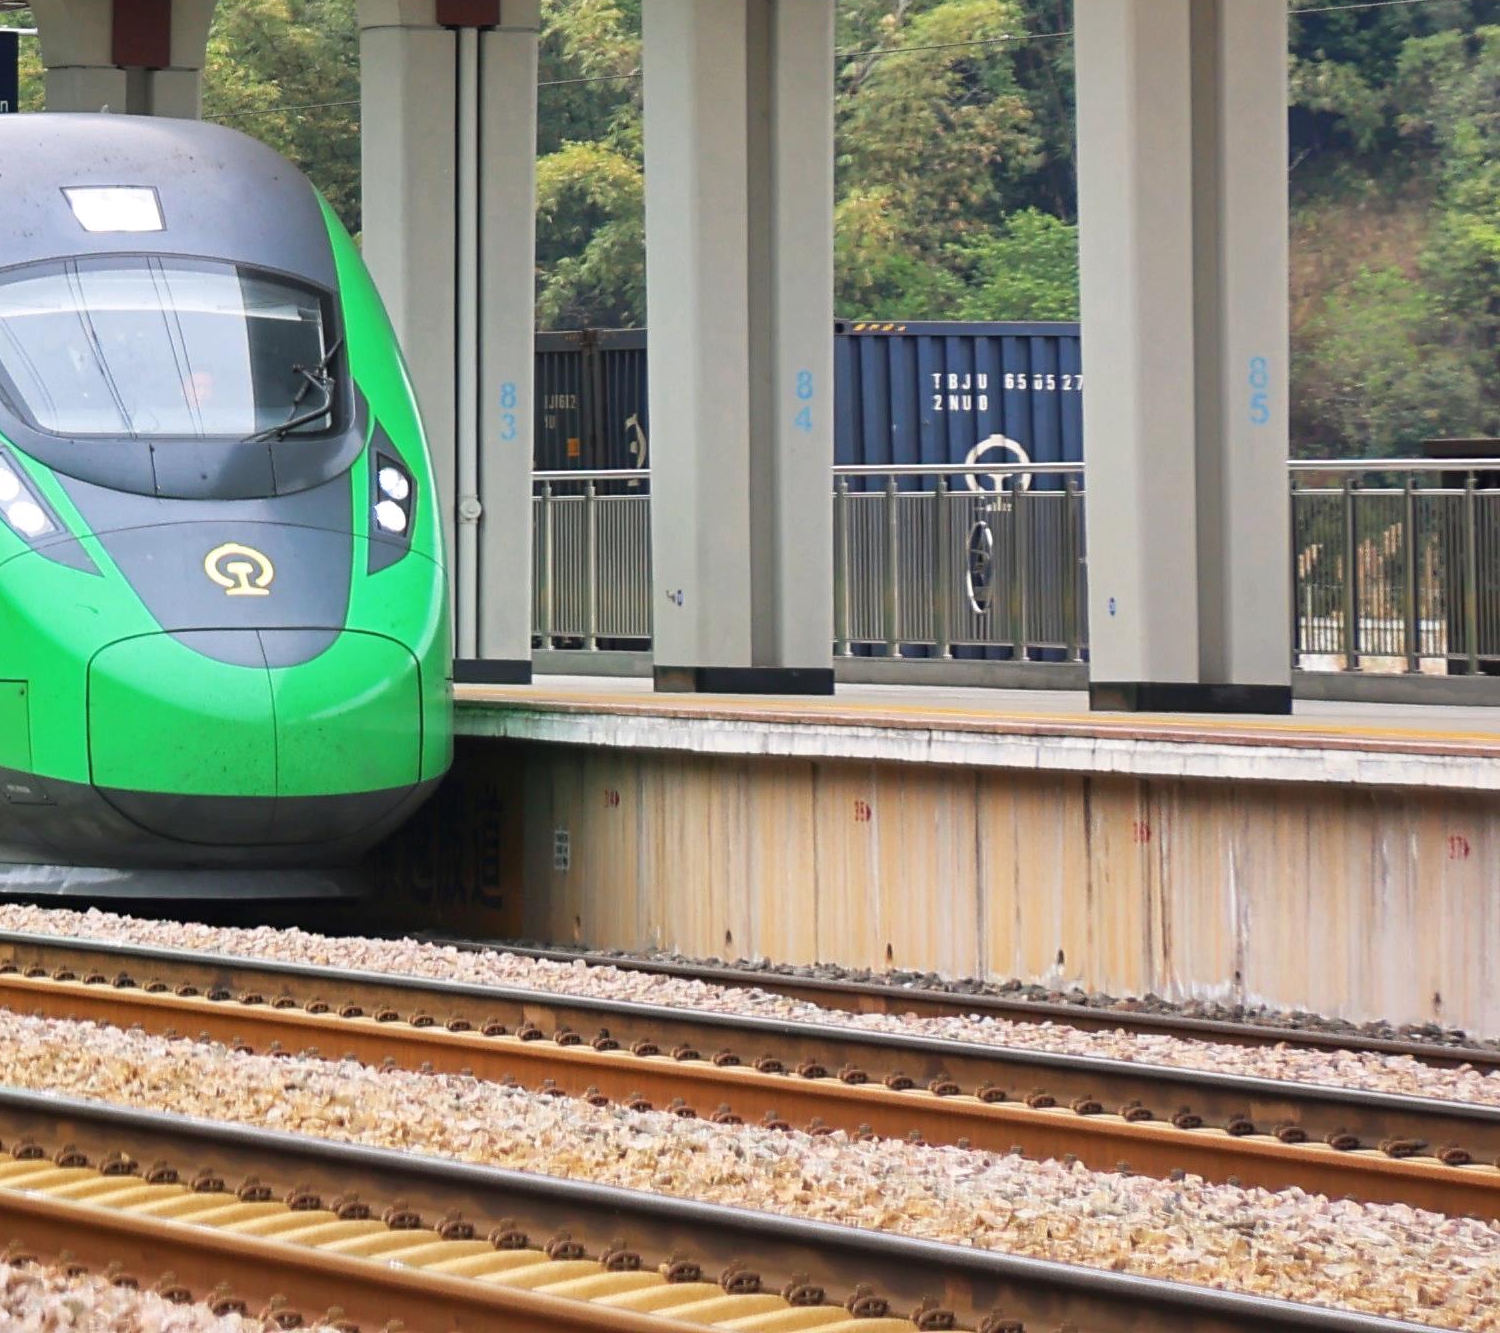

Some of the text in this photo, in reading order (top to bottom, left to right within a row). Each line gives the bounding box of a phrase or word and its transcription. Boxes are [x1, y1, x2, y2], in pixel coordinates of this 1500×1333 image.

[794, 370, 813, 433] 84
[931, 373, 988, 390] TBJU
[1248, 355, 1270, 426] 85
[501, 383, 517, 441] 83
